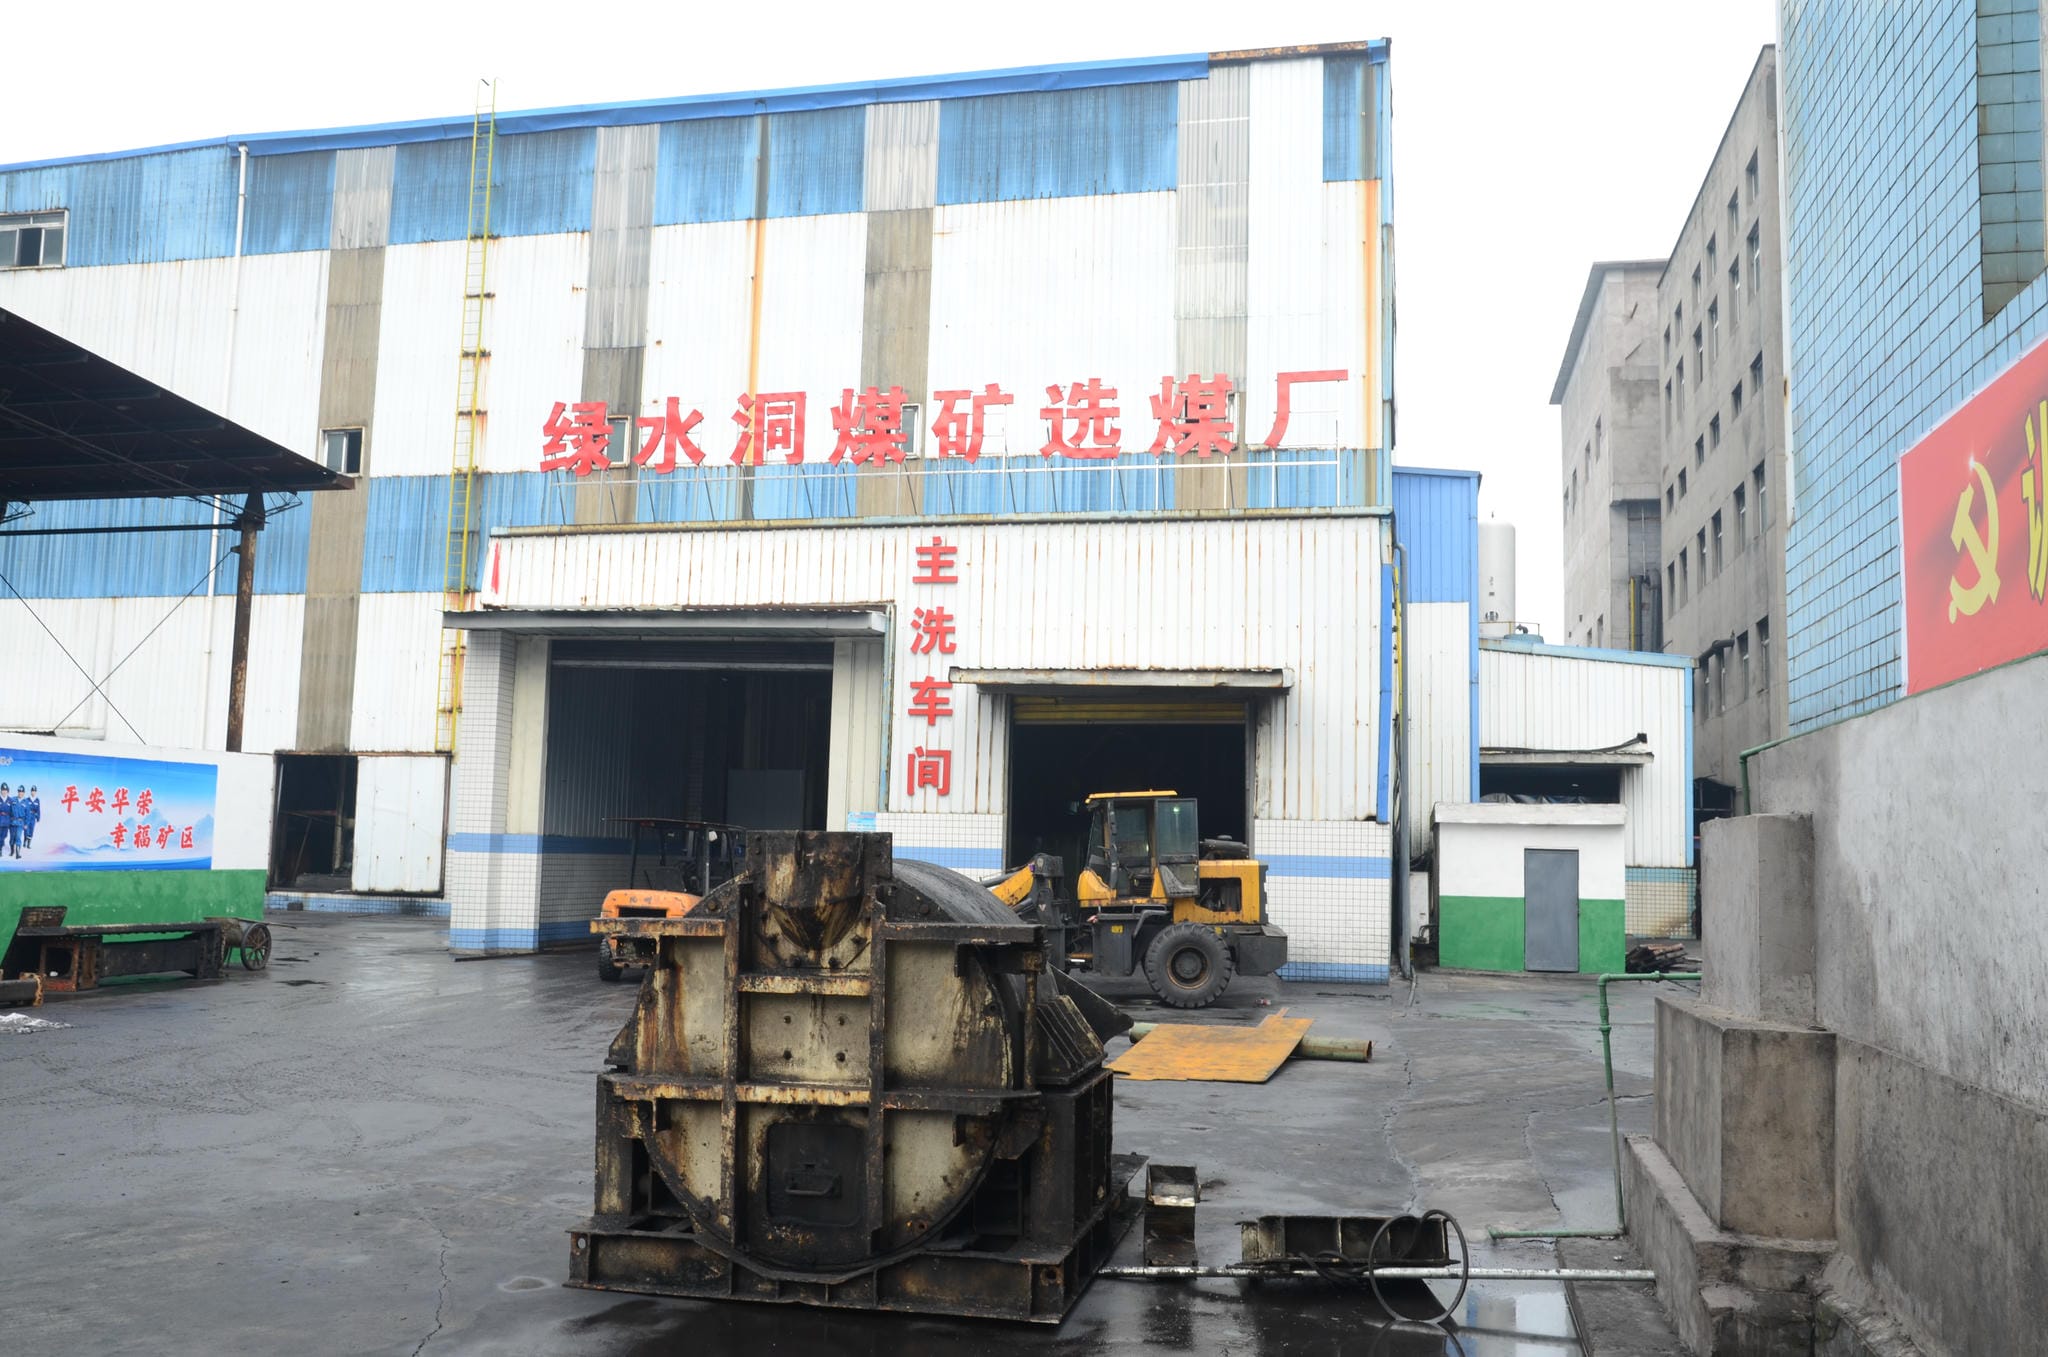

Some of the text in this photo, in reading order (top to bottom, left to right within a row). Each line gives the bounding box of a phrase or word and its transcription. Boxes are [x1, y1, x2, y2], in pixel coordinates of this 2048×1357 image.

[541, 369, 1349, 476] 绿水洞煤矿选煤厂
[907, 536, 958, 796] 主洗车间
[61, 785, 153, 816] 平安华荣
[110, 822, 193, 849] 幸福矿区
